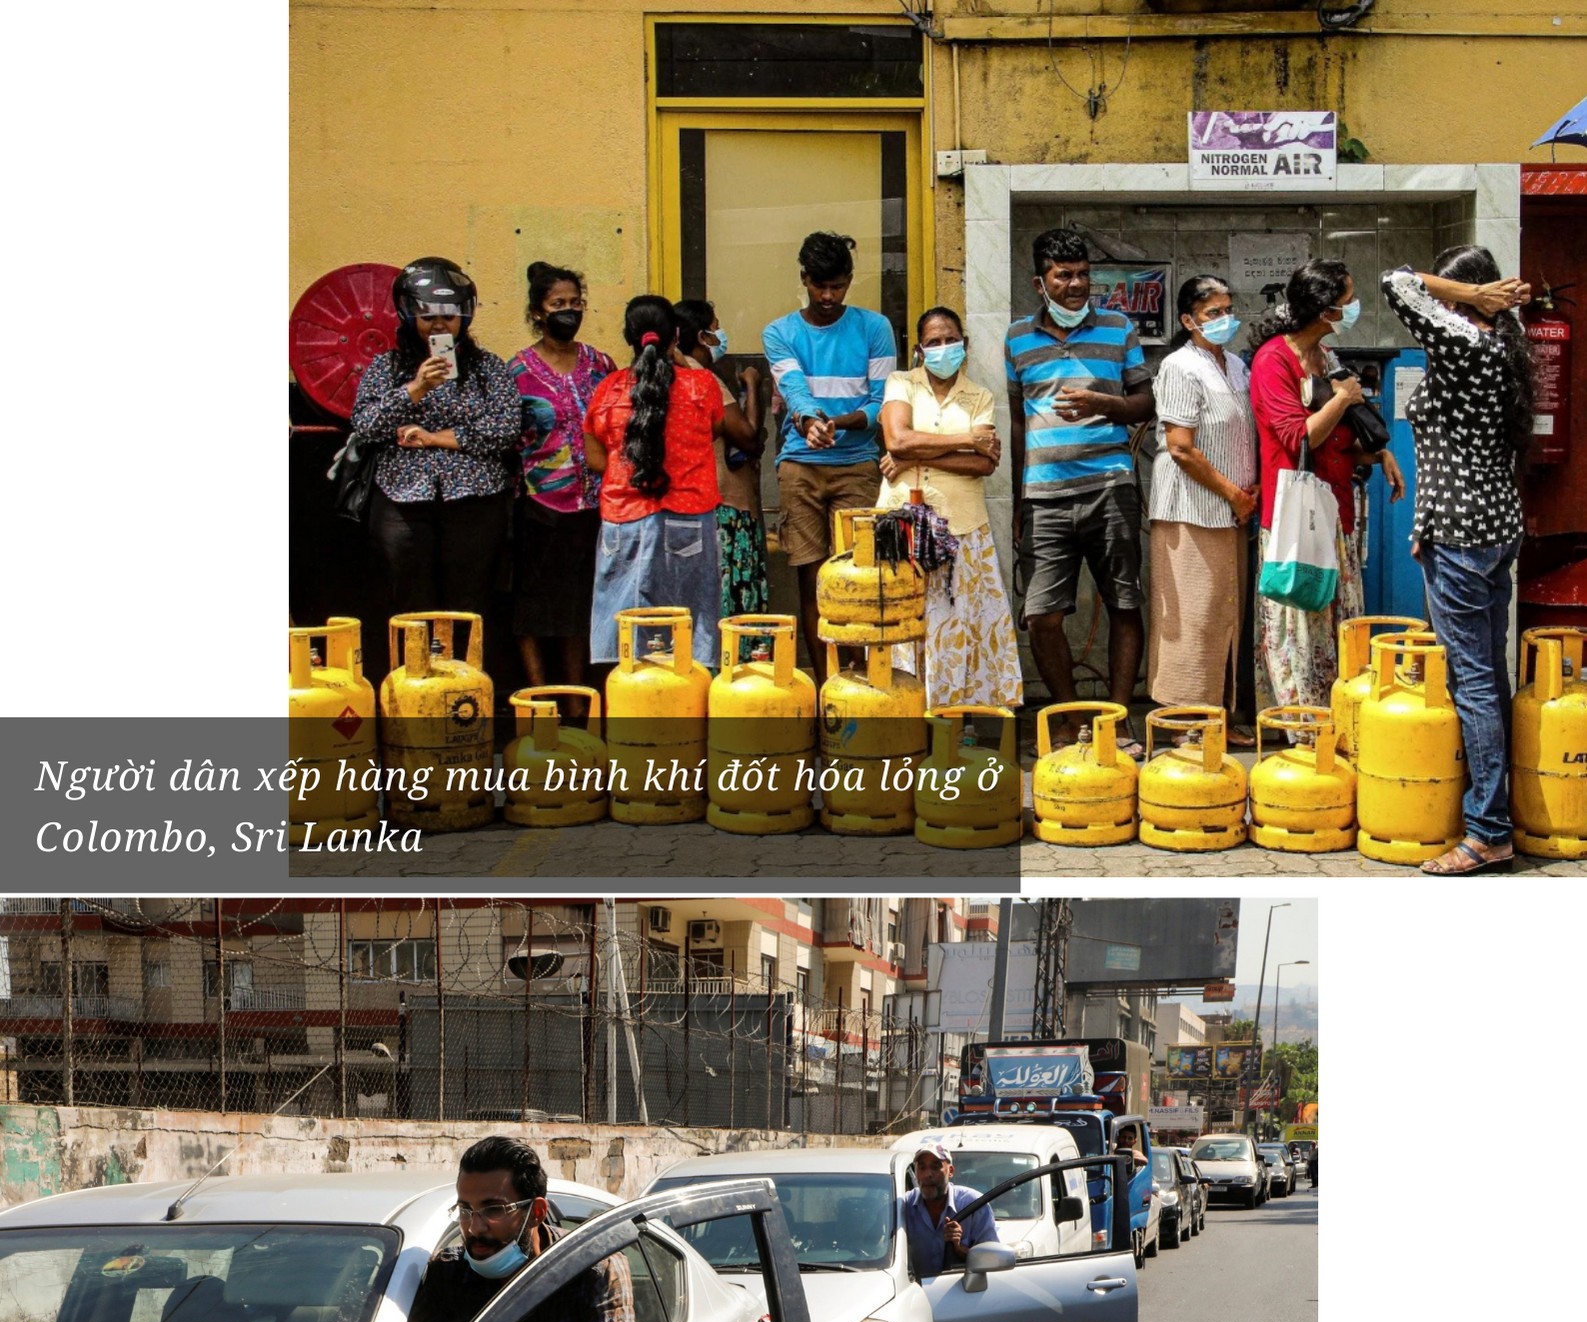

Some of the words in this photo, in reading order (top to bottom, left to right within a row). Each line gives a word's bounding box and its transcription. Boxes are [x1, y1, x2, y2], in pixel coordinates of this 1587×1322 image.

[1201, 153, 1267, 164] NITROGEN
[1273, 153, 1323, 175] AIR
[1211, 165, 1268, 176] NORMAL
[1106, 281, 1163, 314] AIR
[1528, 327, 1565, 338] WATER
